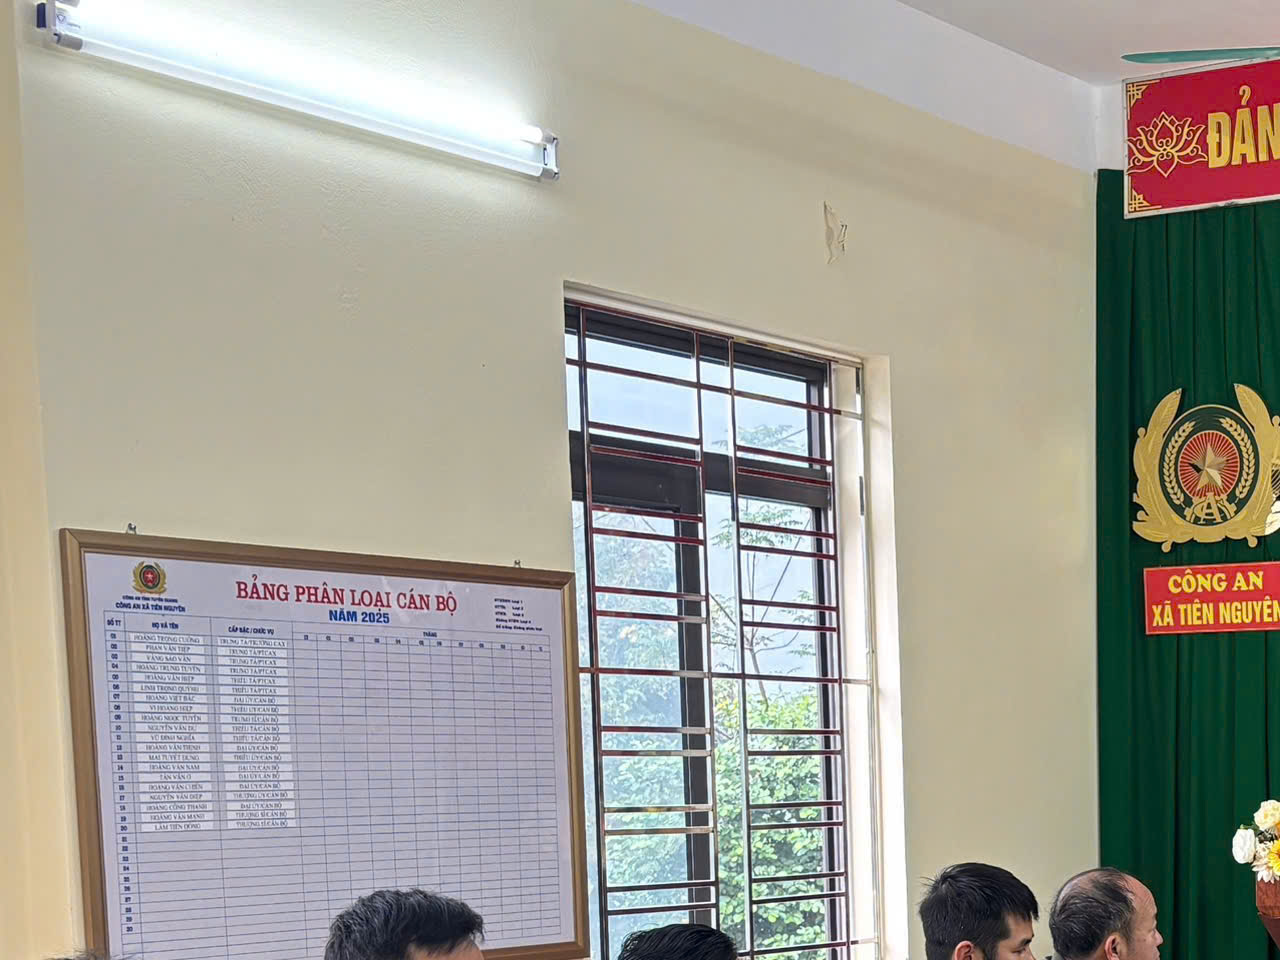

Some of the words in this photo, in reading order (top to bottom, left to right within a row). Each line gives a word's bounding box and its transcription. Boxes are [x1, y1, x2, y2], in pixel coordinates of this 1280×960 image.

[236, 574, 290, 602] BẢNG
[294, 582, 345, 605] PHÂN
[350, 588, 392, 612] LOẠI
[396, 588, 430, 610] CÁN
[435, 592, 457, 616] BỘ
[1168, 568, 1228, 594] CÔNG
[1231, 570, 1264, 591] AN
[329, 608, 358, 623] NĂM
[361, 610, 390, 624] 2025
[1151, 601, 1174, 627] XÃ
[1178, 597, 1214, 626] TIÊN
